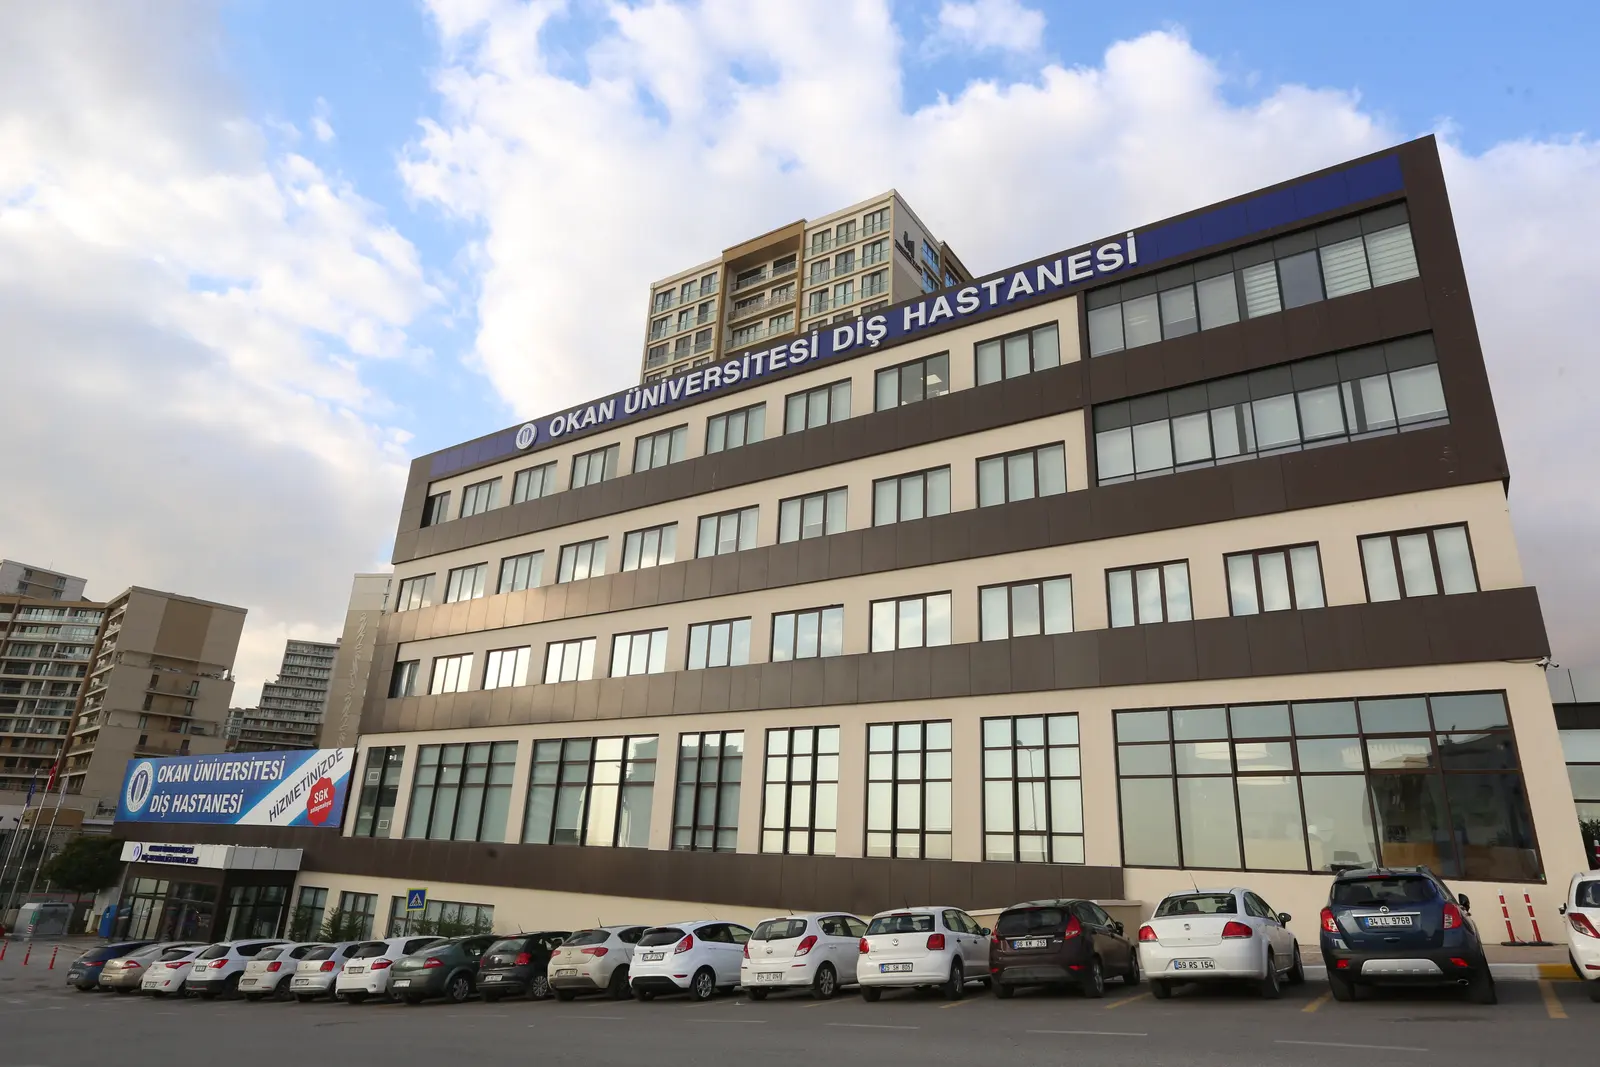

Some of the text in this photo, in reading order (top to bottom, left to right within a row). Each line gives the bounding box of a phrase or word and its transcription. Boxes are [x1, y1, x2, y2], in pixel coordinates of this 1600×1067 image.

[549, 400, 615, 438] OKAN
[624, 331, 819, 415] ÜNİVERSİTESİ
[832, 313, 888, 349] DİŞ
[903, 231, 1138, 332] HASTANESİ
[157, 755, 287, 784] OKAN ÜNİVERSİTESİ
[269, 748, 344, 823] HİZMETİNİZDE
[313, 788, 330, 804] SGK
[149, 789, 245, 817] DİŞ HASTANESİ
[1380, 917, 1389, 925] LL
[1391, 917, 1411, 925] 9768
[1178, 961, 1214, 969] 59 RS 154
